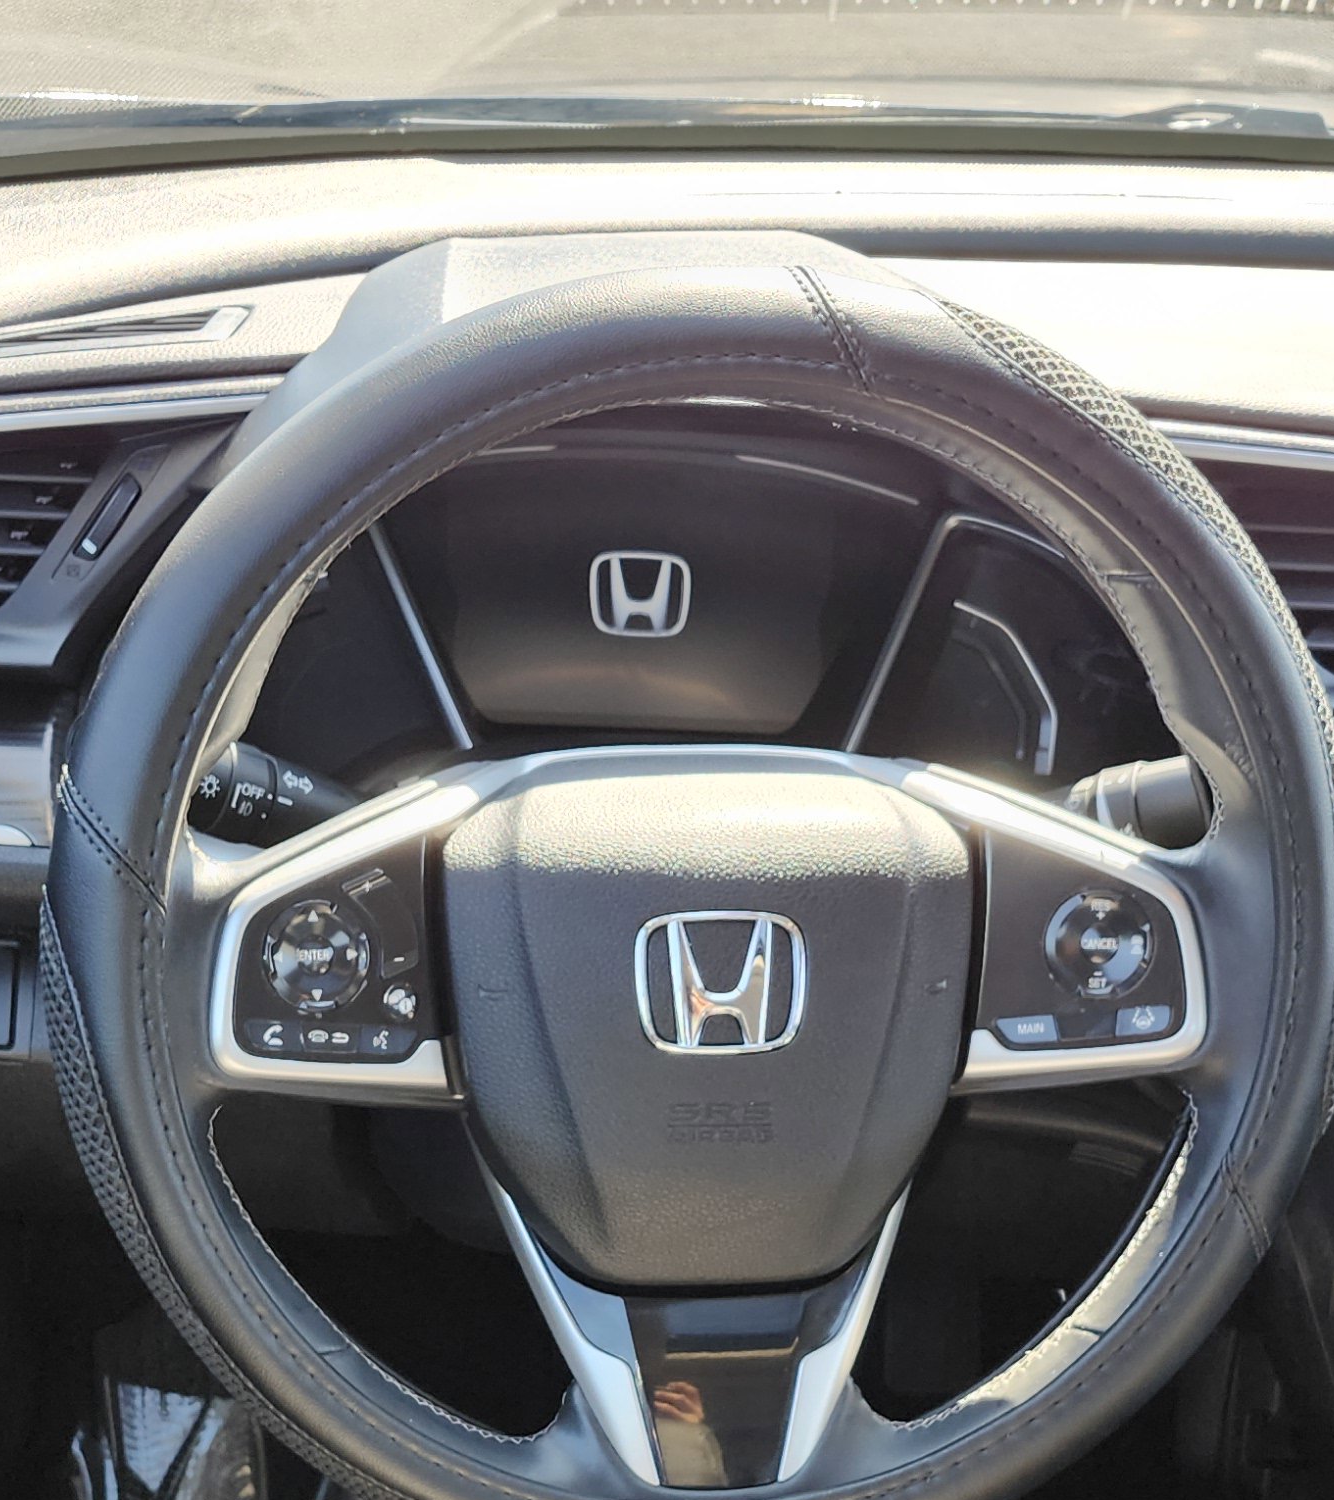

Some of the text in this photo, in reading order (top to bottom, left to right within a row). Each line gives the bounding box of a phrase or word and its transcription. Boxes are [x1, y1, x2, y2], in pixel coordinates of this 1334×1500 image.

[241, 783, 266, 800] OFF
[1090, 901, 1111, 911] RES
[1081, 937, 1118, 950] CANCEL
[297, 949, 330, 961] ENTER
[1088, 977, 1107, 988] SET
[1017, 1022, 1044, 1035] MAIN
